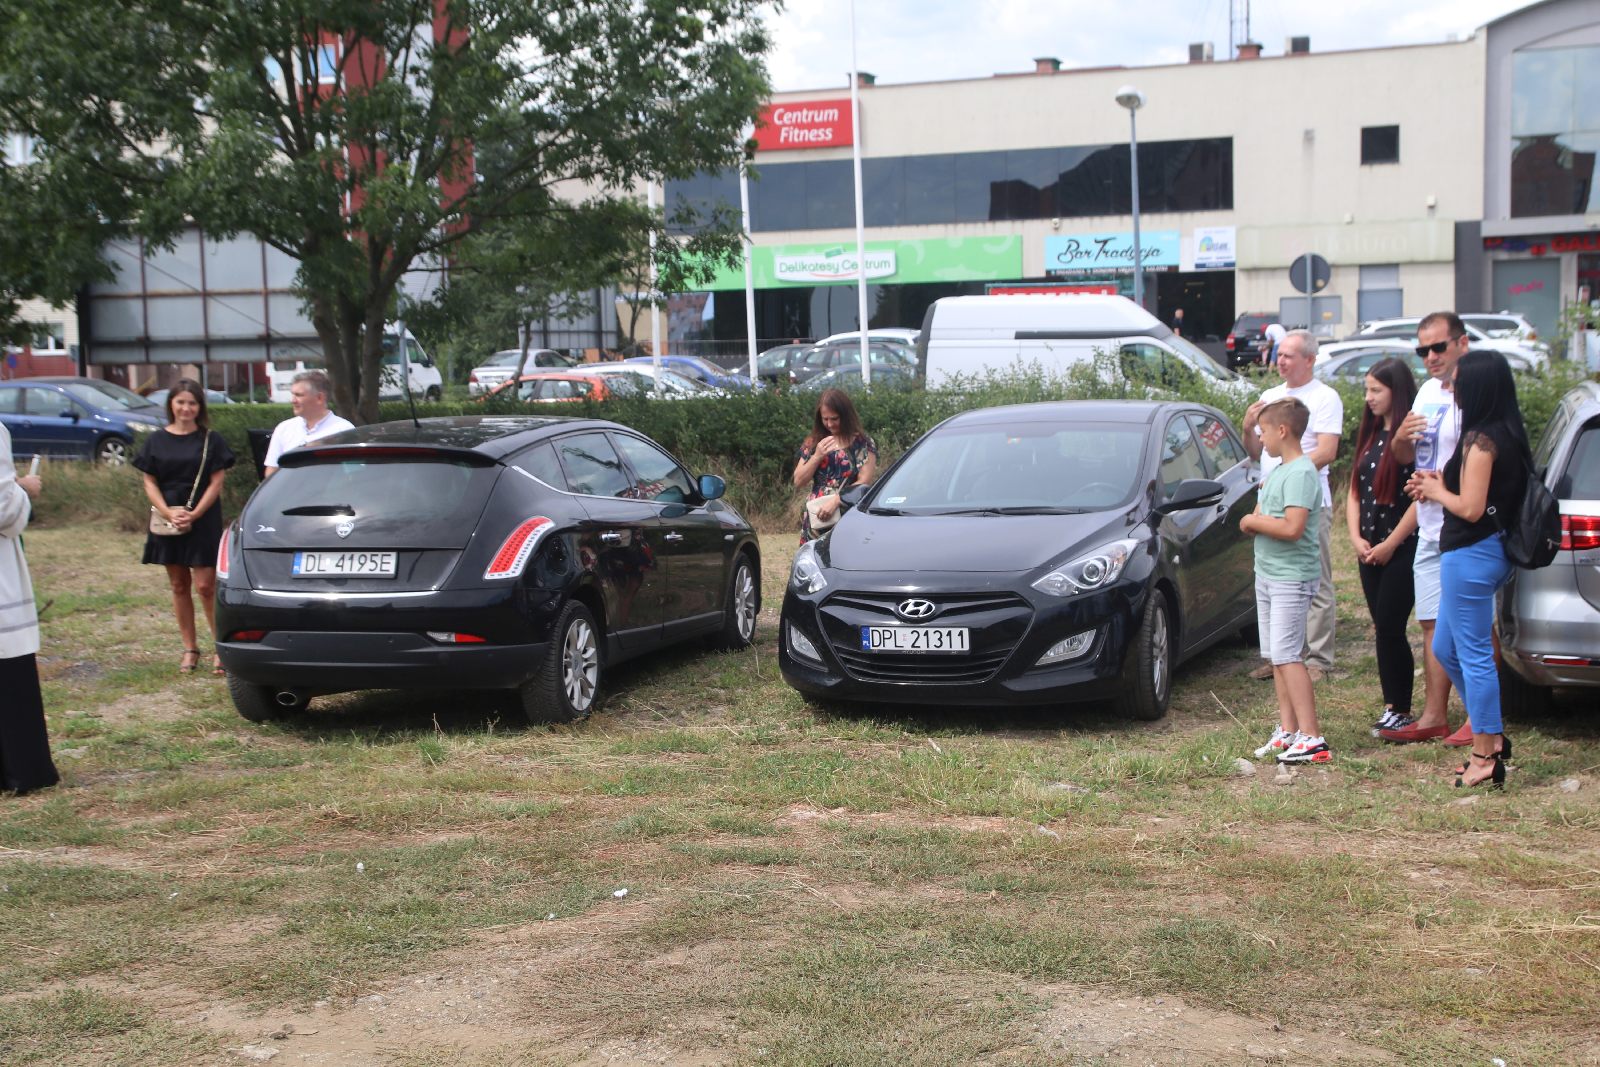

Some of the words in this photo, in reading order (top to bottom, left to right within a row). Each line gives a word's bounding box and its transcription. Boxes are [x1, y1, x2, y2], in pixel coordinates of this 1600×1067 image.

[773, 107, 839, 126] Centrum
[779, 126, 833, 144] Fitness
[1057, 238, 1092, 264] Bar
[1551, 234, 1600, 253] GAL
[779, 259, 840, 274] Delikatesy
[841, 258, 891, 271] Cetrum
[305, 553, 326, 573] DL
[334, 553, 392, 573] 4195E
[871, 629, 904, 648] DPL
[910, 629, 964, 649] 21311
